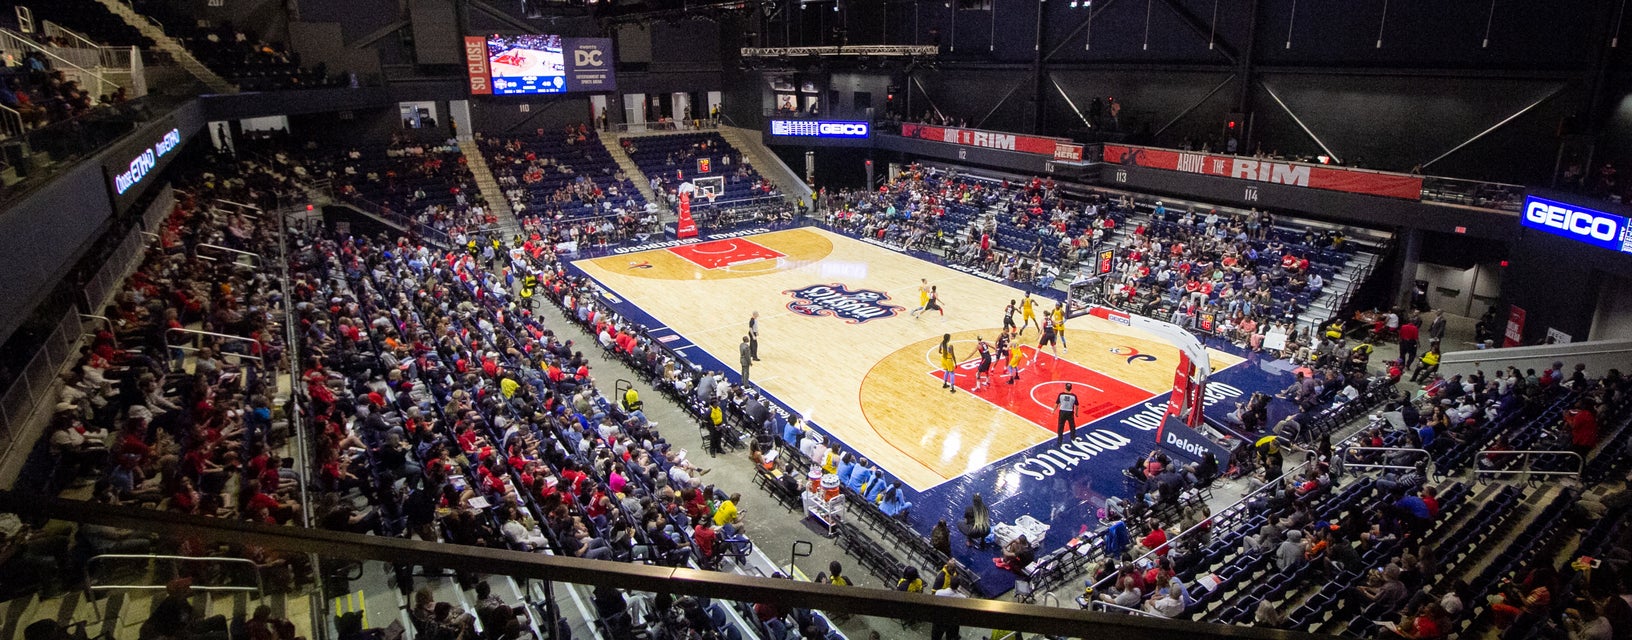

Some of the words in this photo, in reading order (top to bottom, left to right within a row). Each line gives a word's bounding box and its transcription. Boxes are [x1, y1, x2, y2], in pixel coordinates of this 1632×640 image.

[467, 41, 485, 73] CLOSE
[471, 77, 486, 90] SO
[820, 123, 867, 135] GEICO
[944, 128, 960, 144] ABOVE
[974, 131, 1016, 150] RIM
[1054, 150, 1079, 160] HERE
[1176, 153, 1206, 174] ABOVE
[1212, 159, 1225, 175] THE
[1231, 158, 1311, 187] RIM
[1116, 172, 1127, 183] 113
[1244, 189, 1258, 202] 114
[1526, 201, 1617, 242] GEICO
[1109, 314, 1129, 324] GEICO
